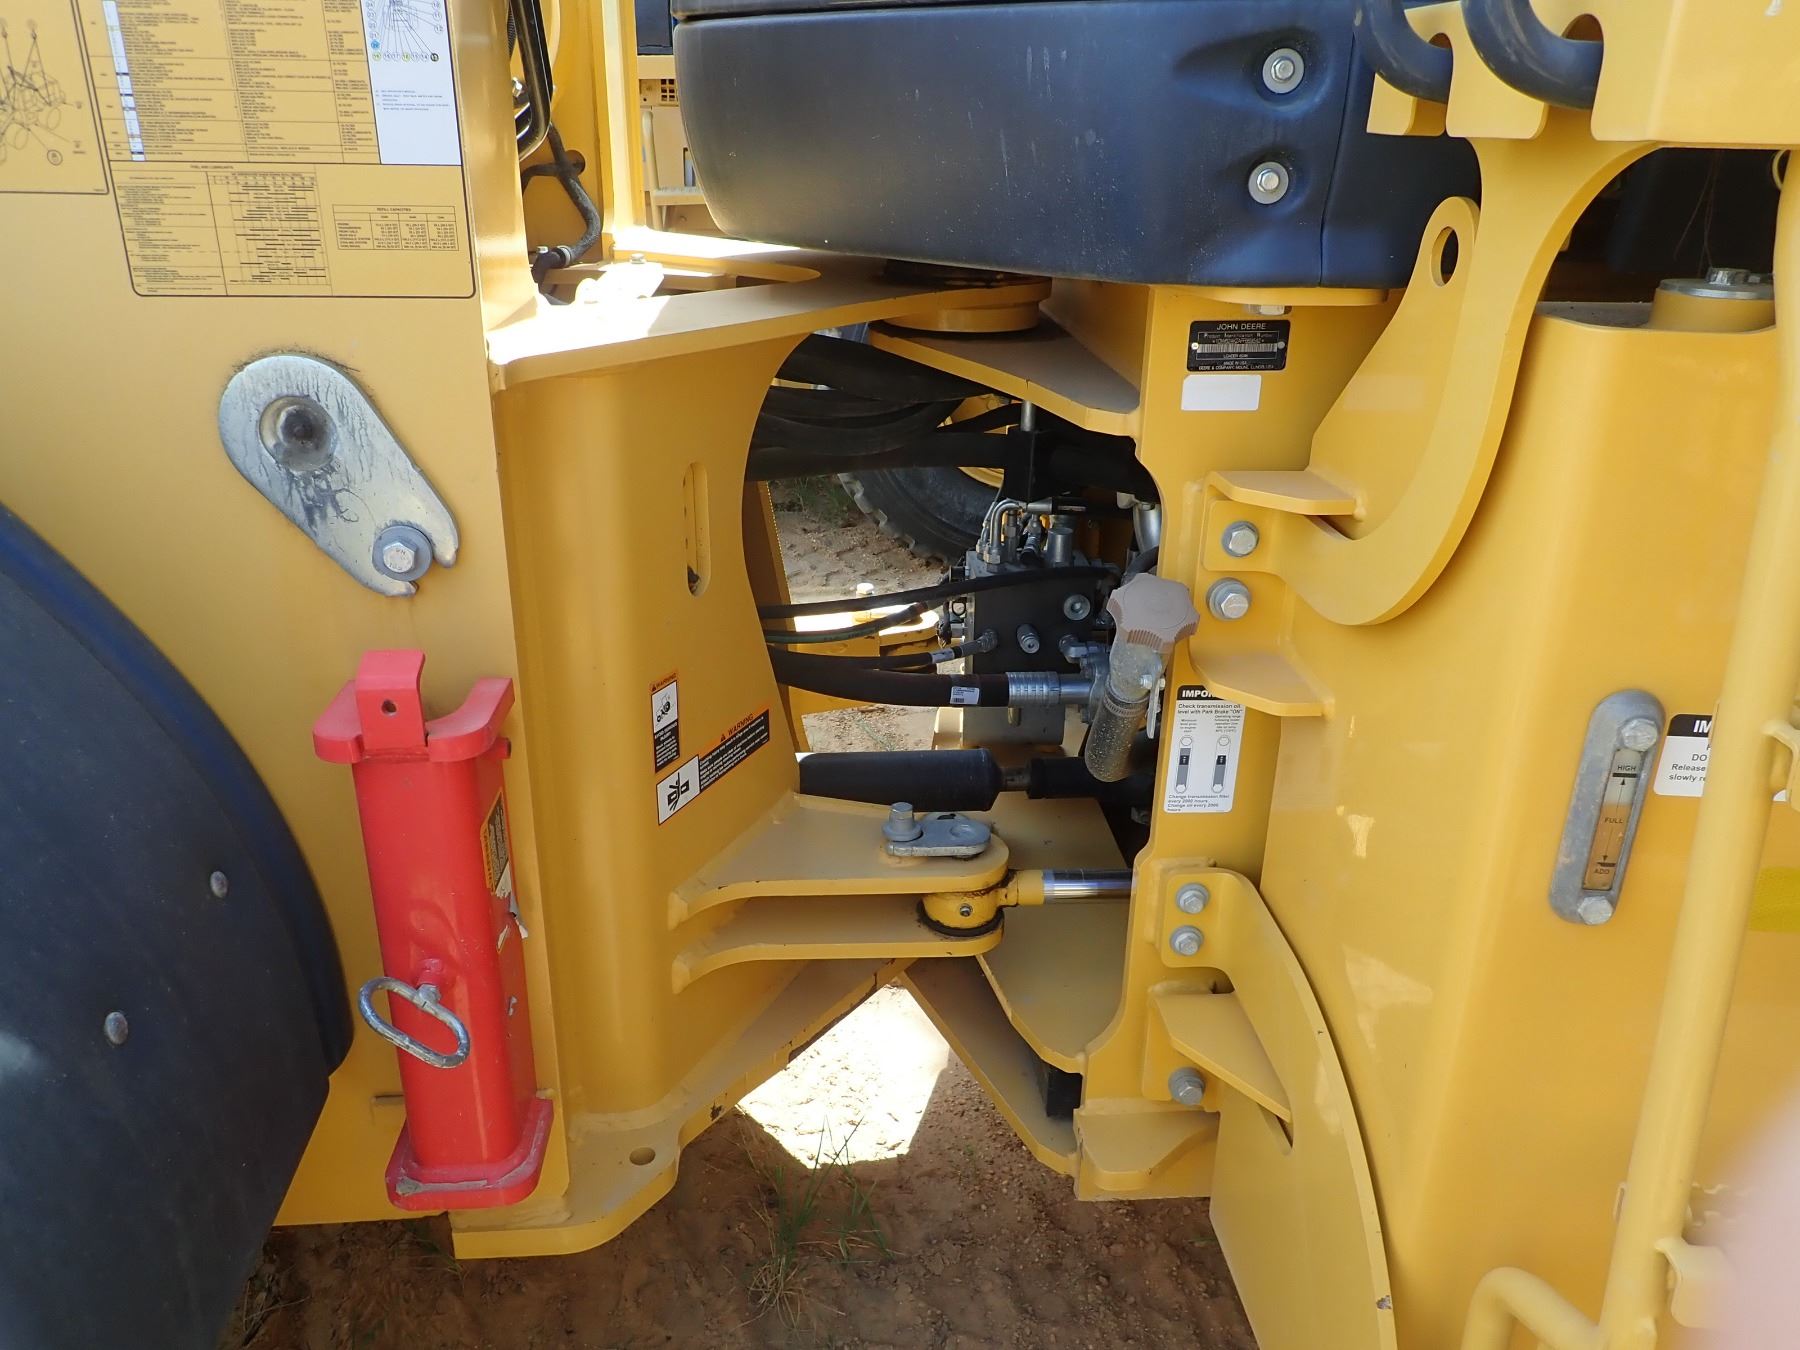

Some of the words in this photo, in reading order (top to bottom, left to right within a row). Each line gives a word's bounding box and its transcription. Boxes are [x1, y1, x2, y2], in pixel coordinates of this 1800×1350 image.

[1216, 323, 1239, 331] JOHN
[727, 713, 754, 736] WARNING
[1691, 753, 1708, 762] DO
[1671, 763, 1706, 771] Release
[1668, 774, 1697, 783] slowly
